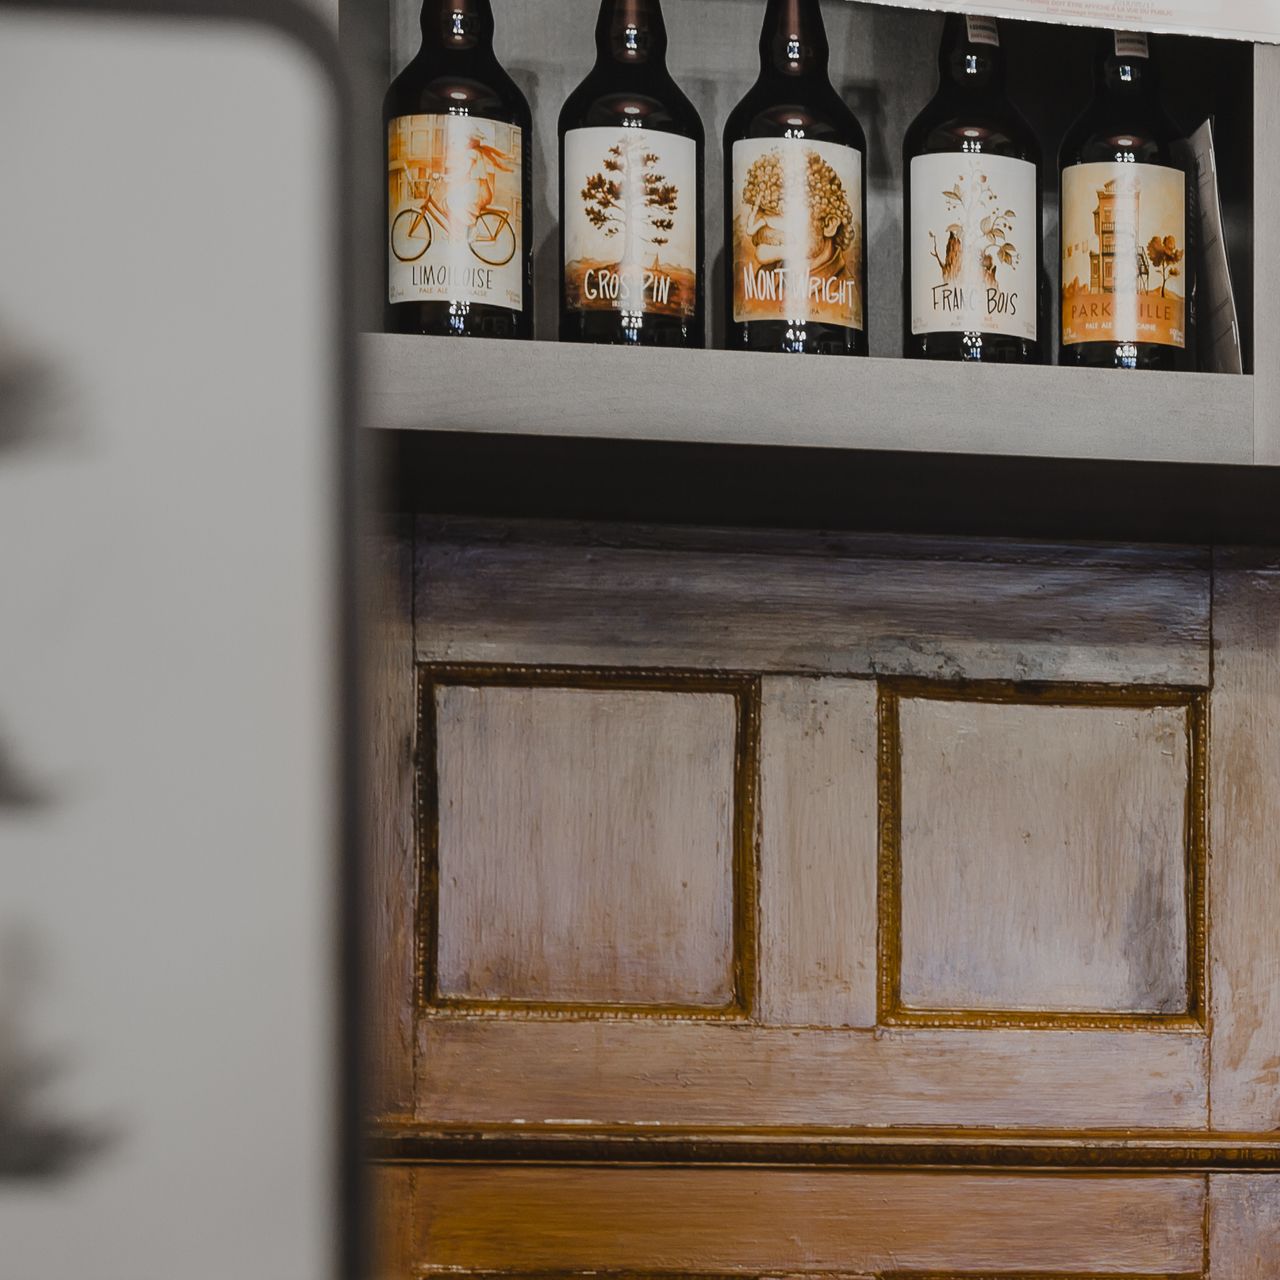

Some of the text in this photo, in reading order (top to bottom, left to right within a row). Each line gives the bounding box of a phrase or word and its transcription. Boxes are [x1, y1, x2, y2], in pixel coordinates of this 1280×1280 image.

[640, 271, 671, 305] PIN
[743, 261, 790, 302] MONT
[986, 286, 1018, 316] BOIS
